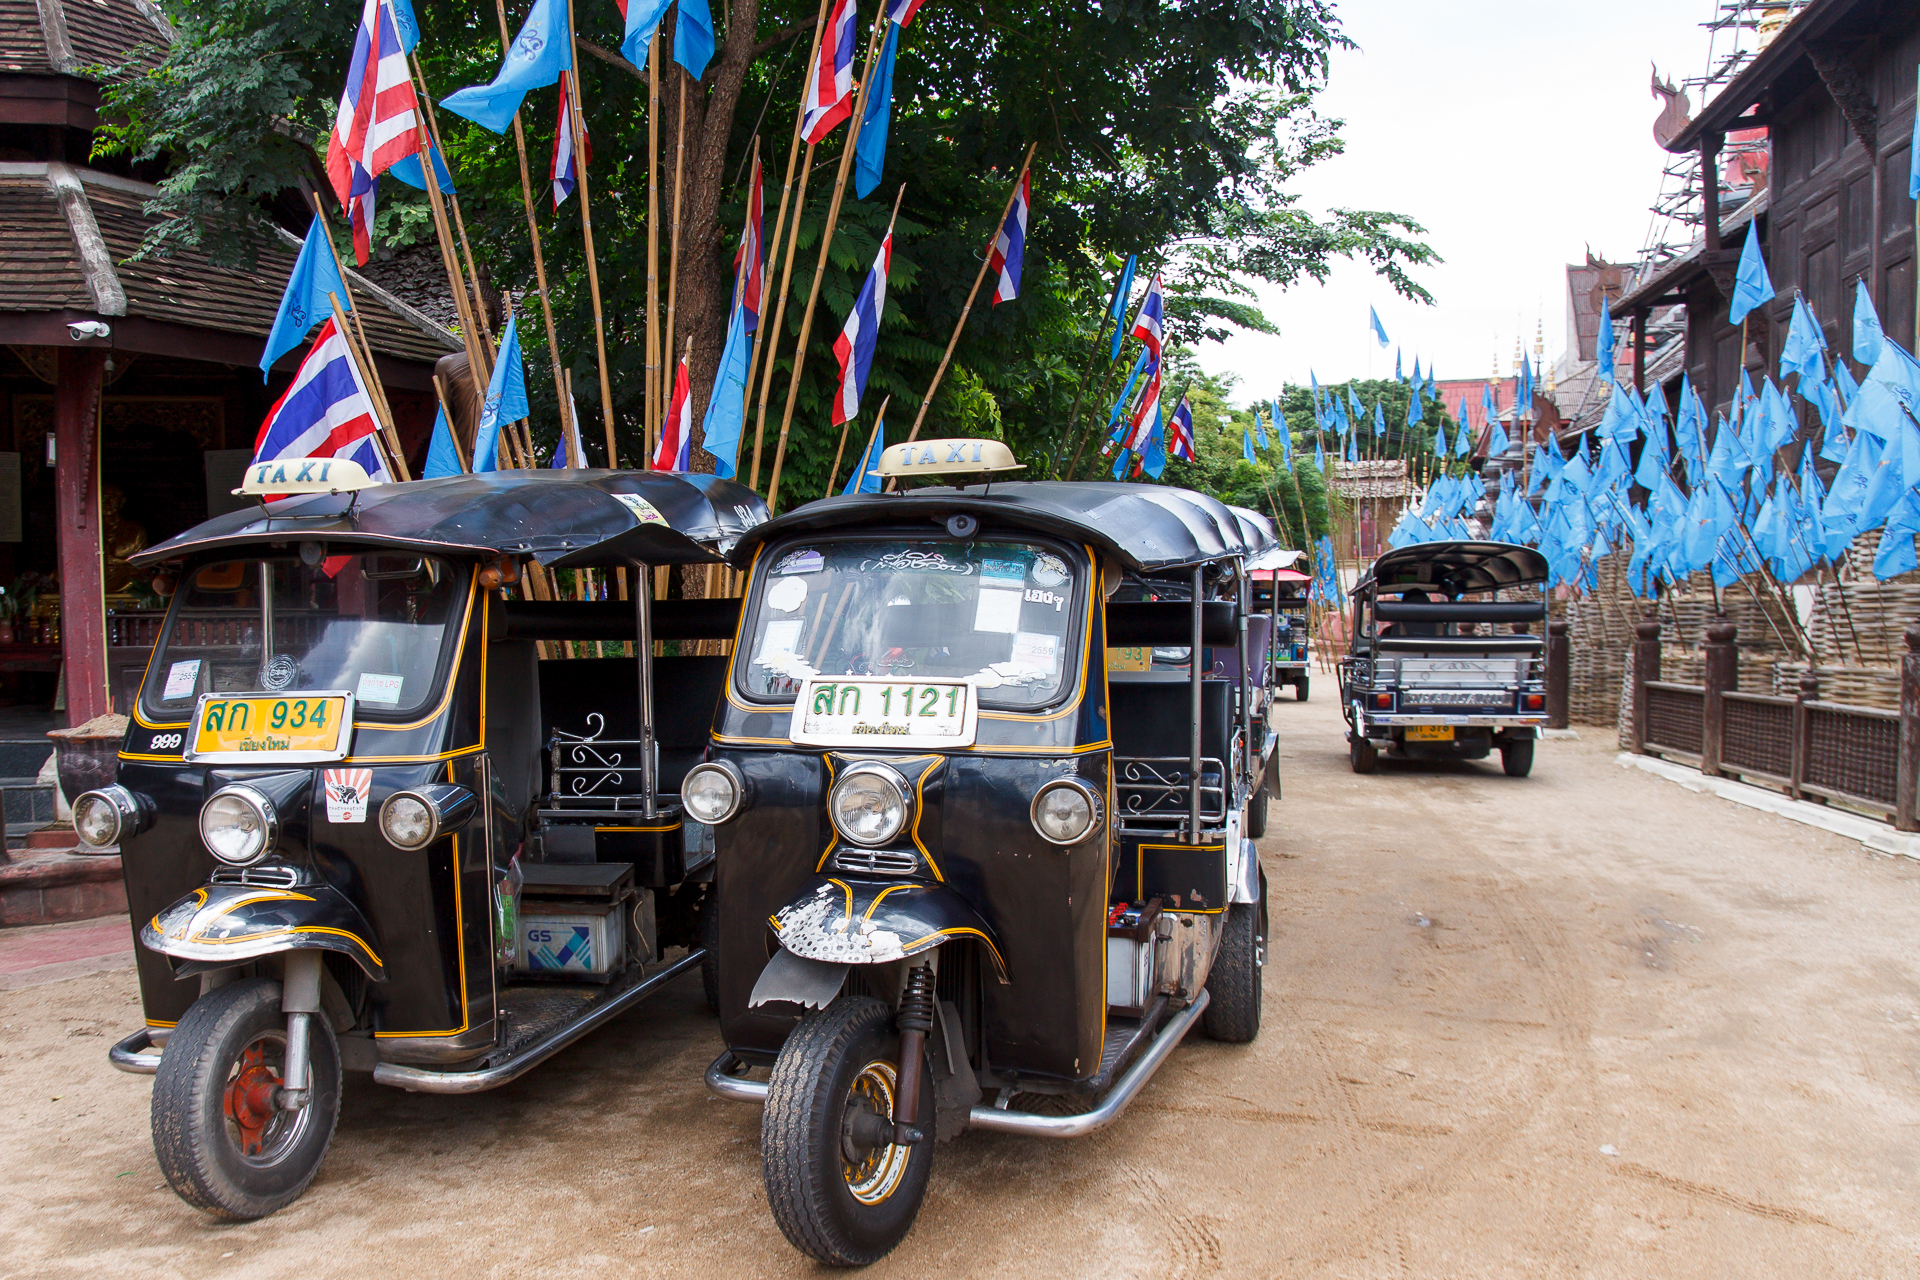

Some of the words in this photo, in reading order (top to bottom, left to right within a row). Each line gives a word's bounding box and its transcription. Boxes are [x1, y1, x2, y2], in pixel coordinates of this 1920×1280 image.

[900, 442, 982, 465] TAXI
[257, 461, 331, 483] TAXI
[1031, 645, 1054, 656] 2559
[179, 671, 197, 681] 2559
[385, 679, 399, 689] LPG
[814, 683, 861, 716] สก
[881, 686, 959, 718] 1121
[206, 700, 250, 732] สก
[270, 700, 328, 730] 934
[150, 734, 182, 749] 999
[239, 736, 292, 751] เชียงใหม่
[528, 930, 552, 942] GS
